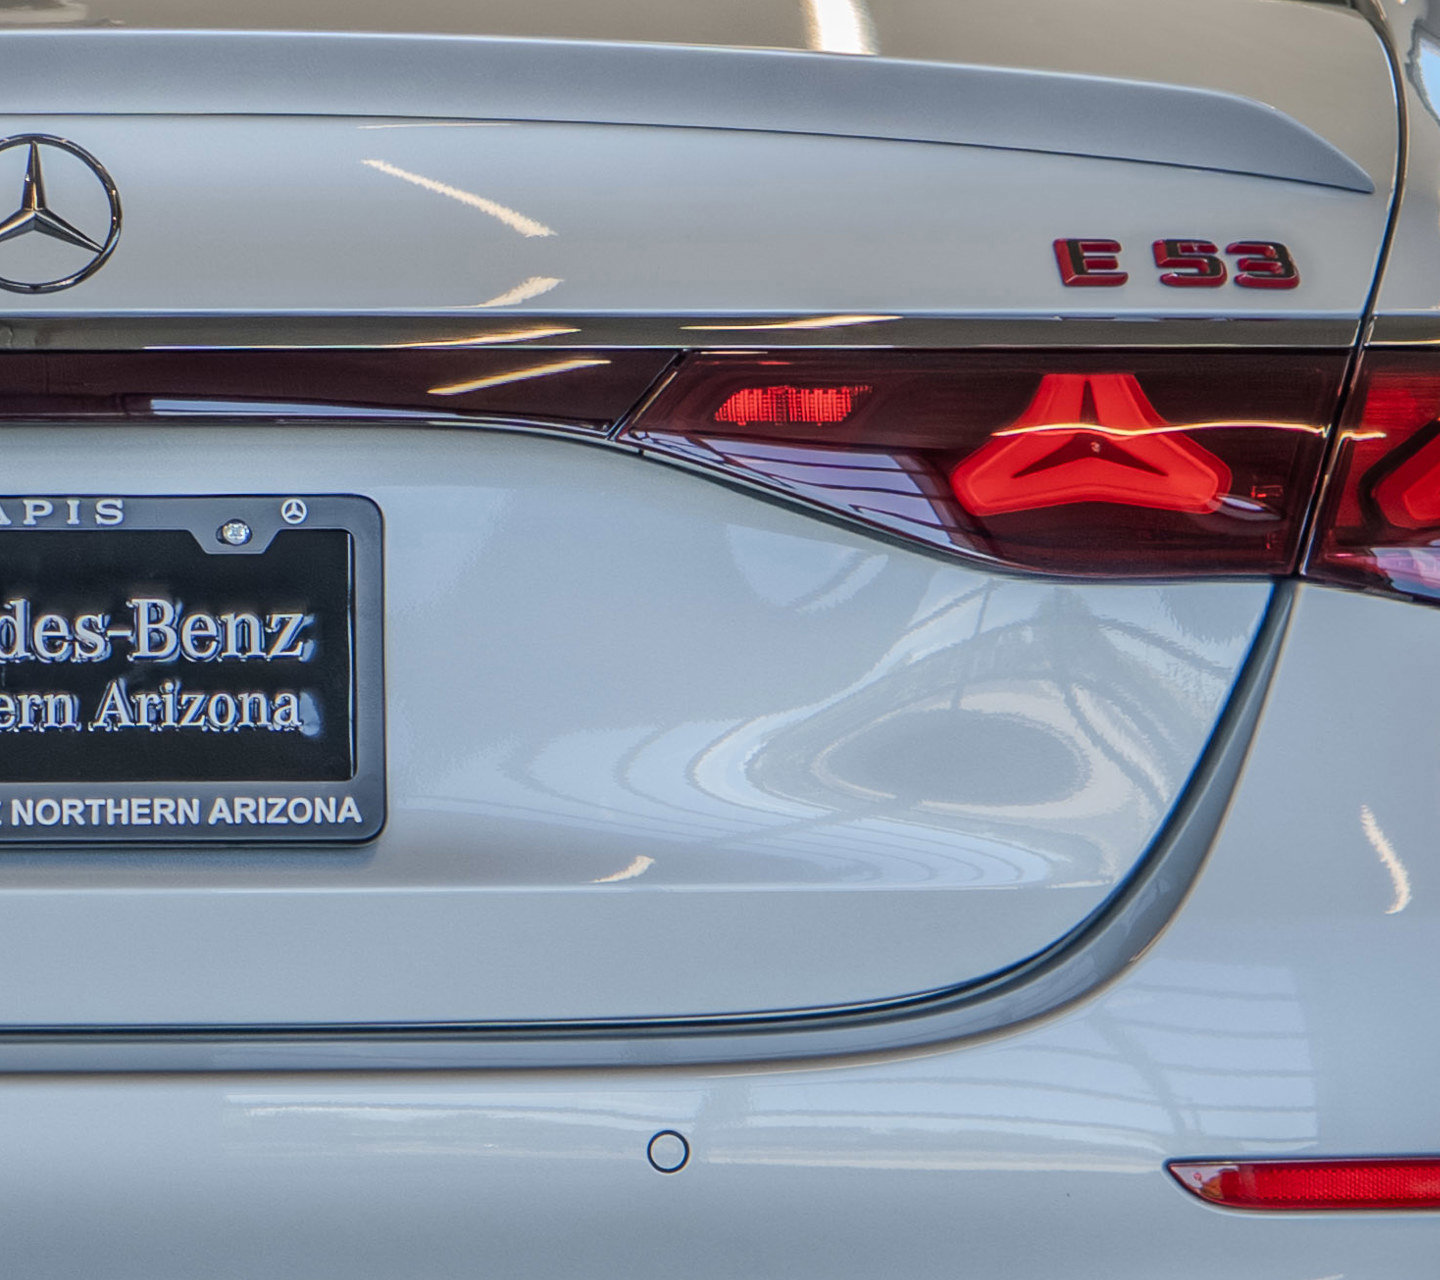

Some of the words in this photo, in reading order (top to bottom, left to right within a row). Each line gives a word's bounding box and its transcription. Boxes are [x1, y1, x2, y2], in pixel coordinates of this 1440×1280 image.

[1052, 238, 1129, 287] E
[1152, 238, 1301, 290] 53
[90, 681, 303, 732] Arizona
[10, 797, 200, 827] NORTHERN
[207, 796, 363, 825] ARIZONA
